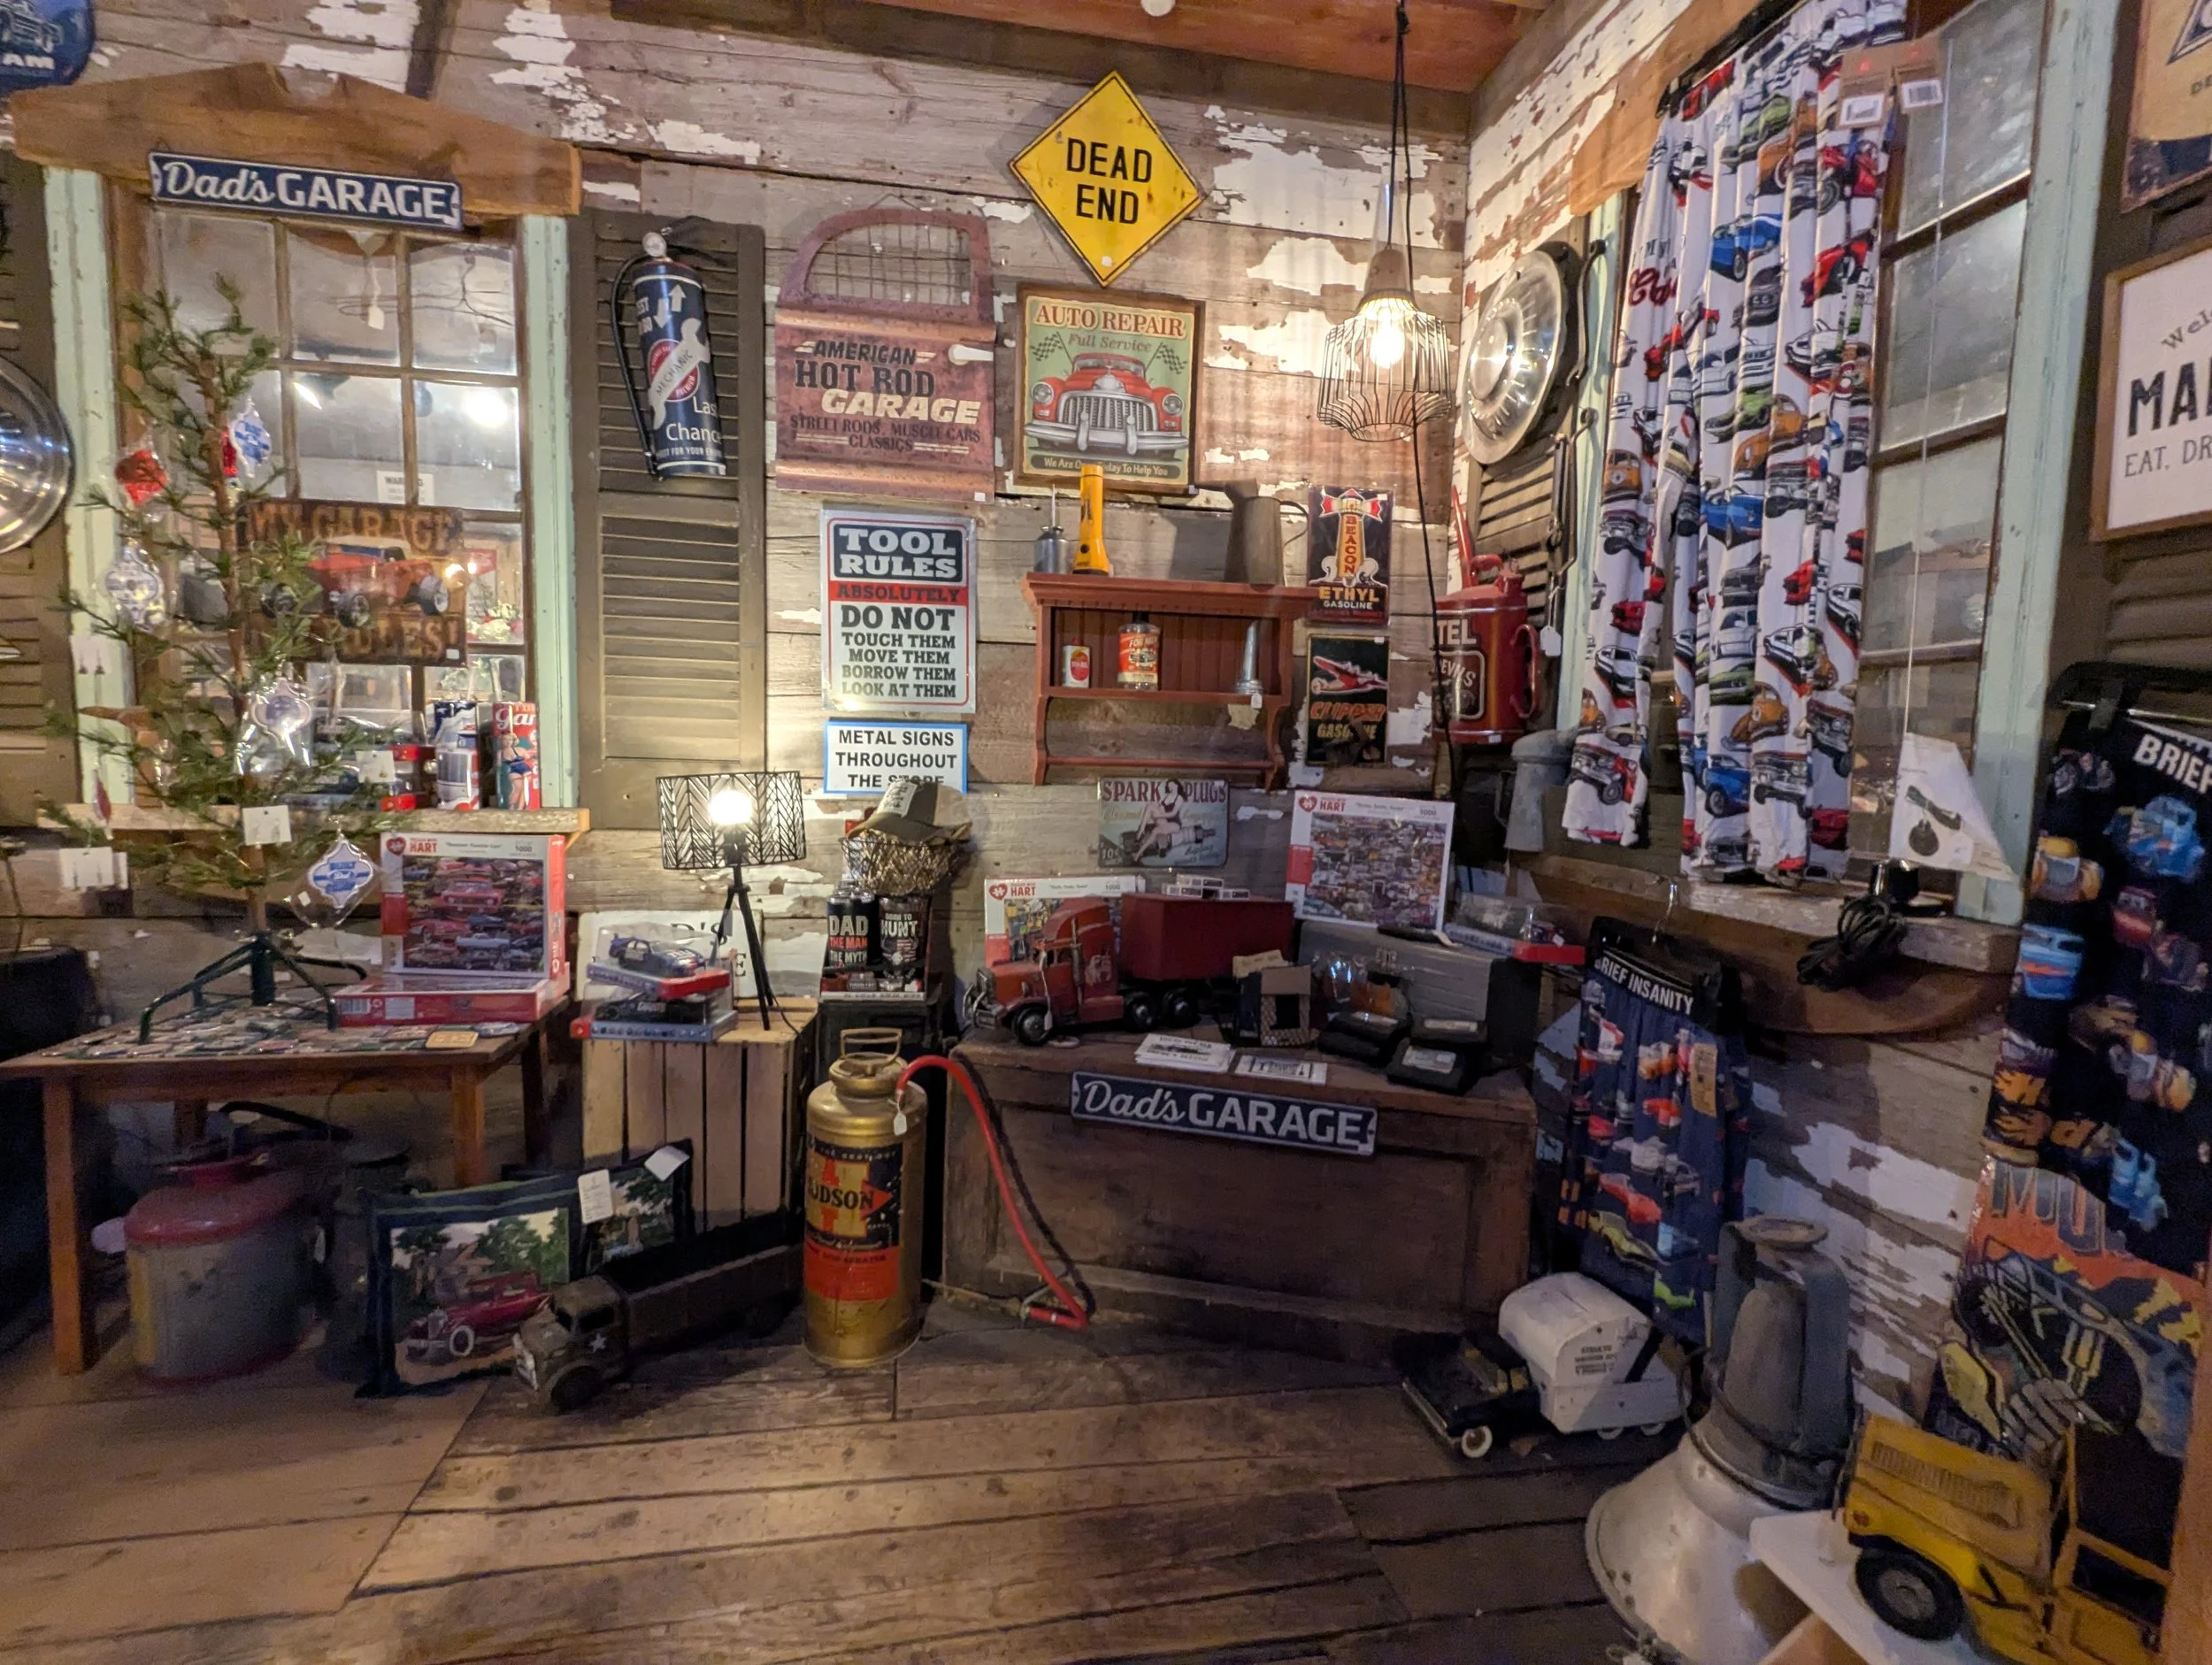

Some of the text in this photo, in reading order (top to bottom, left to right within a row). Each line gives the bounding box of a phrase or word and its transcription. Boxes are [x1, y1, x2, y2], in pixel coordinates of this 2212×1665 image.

[1066, 138, 1152, 183] DEAD
[163, 161, 447, 220] Dad's GARAGE
[1076, 183, 1140, 225] END
[1035, 303, 1184, 336] AUTO REPAIR
[2161, 310, 2212, 350] Wel
[812, 339, 917, 365] AMERICAN
[1067, 334, 1152, 353] Full Service
[656, 350, 694, 396] MECHANIC
[795, 359, 935, 397] HOT ROD
[821, 387, 981, 425] GARAGE
[665, 422, 722, 444] Chanc
[790, 413, 838, 433] STREET
[890, 422, 941, 441] MUSCLE
[945, 426, 981, 443] CARS
[685, 446, 704, 457] YOUR
[848, 434, 916, 453] CLASSICS
[1043, 457, 1057, 468] We
[1058, 458, 1073, 469] Are
[1122, 463, 1133, 474] To
[1133, 464, 1151, 477] Help
[1153, 465, 1169, 477] You
[839, 527, 956, 556] TOOL
[1344, 514, 1360, 574] BEACON
[839, 553, 957, 579] RULES
[836, 582, 962, 603] ABSOLUTELY
[1318, 586, 1380, 603] ETHYL
[1323, 600, 1373, 610] GASOLINE
[841, 604, 956, 632] DO NOT
[841, 631, 956, 649] TOUCH THEM
[849, 648, 950, 665] MOVE THEM
[841, 664, 956, 682] BORROW THEM
[841, 680, 956, 699] LOOK AT THEM
[1310, 701, 1386, 723] CLIPPER
[839, 729, 955, 747] METAL SIGNS
[1317, 723, 1378, 741] GASOE
[835, 751, 958, 769] THROUGHOUT
[848, 773, 882, 788] THE
[1102, 779, 1226, 803] SPARK PLUGS
[1318, 799, 1347, 812] HART
[409, 841, 438, 854] HART
[1010, 886, 1036, 897] HART
[828, 915, 869, 937] DAD
[880, 919, 918, 938] HUNT
[830, 936, 868, 949] THE MAN
[830, 950, 843, 963] THE
[1627, 973, 1694, 1016] INSANITY
[1082, 1079, 1363, 1146] Dad's GARAGE
